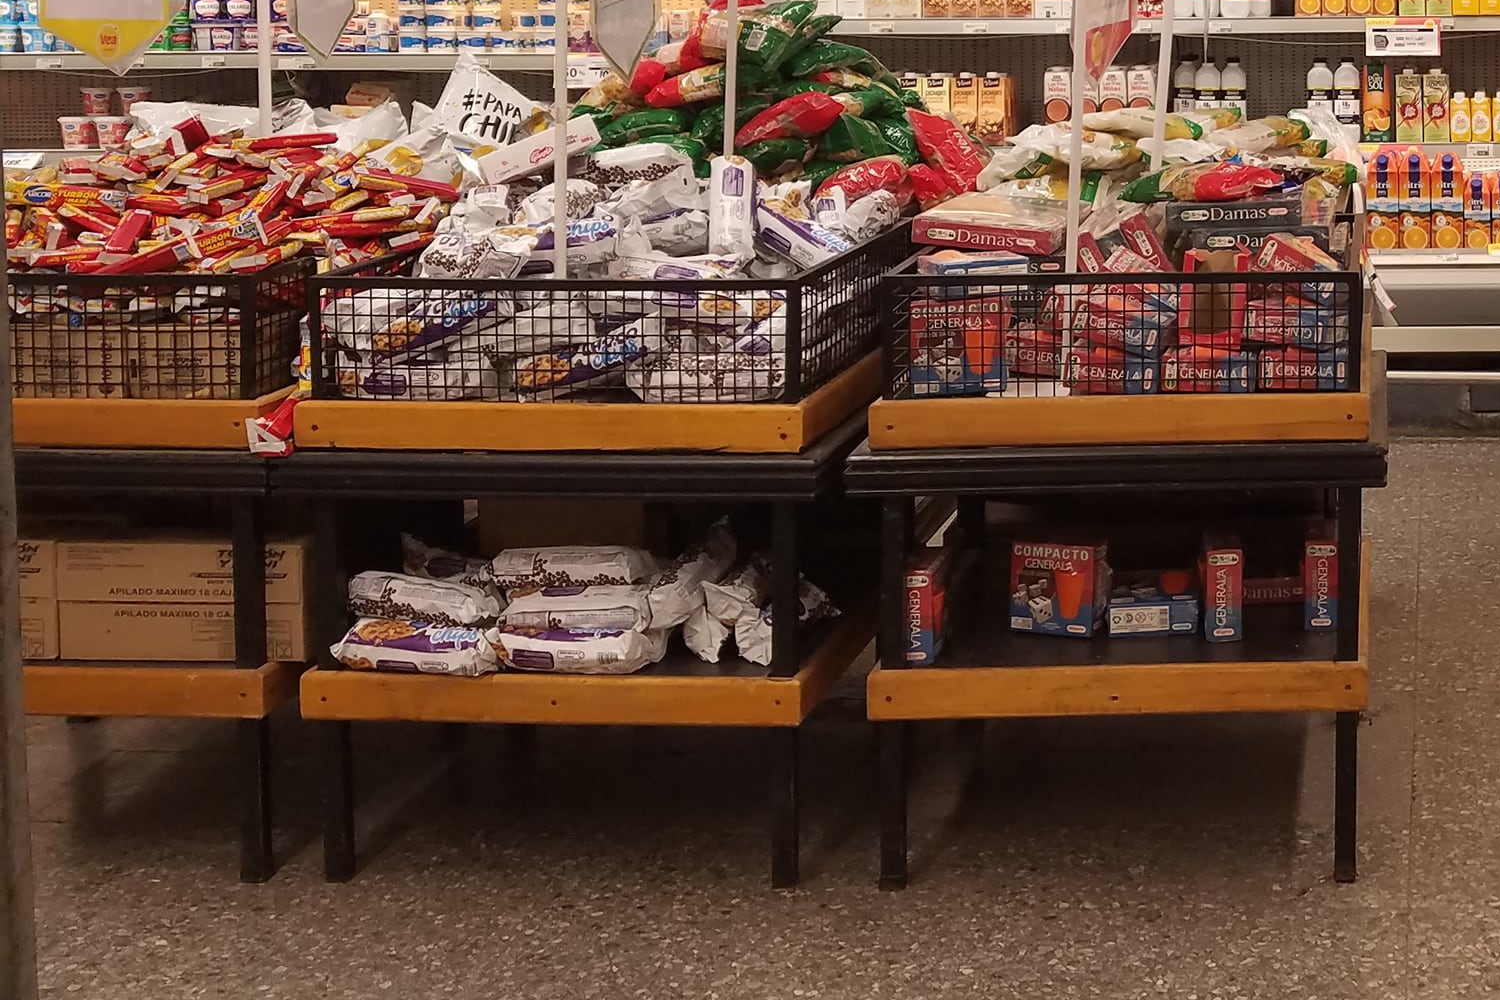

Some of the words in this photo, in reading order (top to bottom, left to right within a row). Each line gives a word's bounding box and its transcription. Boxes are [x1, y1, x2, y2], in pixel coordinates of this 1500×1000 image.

[101, 32, 117, 46] Vea
[1368, 81, 1384, 90] SOL
[461, 88, 522, 122] #PAPA
[1403, 181, 1426, 190] citric
[1436, 181, 1459, 190] citric
[25, 190, 52, 201] ARCOR
[57, 190, 99, 200] TURRÓN
[1467, 197, 1486, 207] citric
[1210, 206, 1267, 222] Damas
[813, 228, 849, 251] chips
[956, 228, 1014, 248] Damas
[911, 303, 998, 316] COMPACTO
[927, 317, 987, 330] GENERALA
[591, 336, 640, 367] chips
[1082, 364, 1141, 381] GENERALA
[1180, 367, 1238, 380] GENERALA
[1275, 364, 1334, 378] GENERALA
[1013, 545, 1089, 561] COMPACTO
[1025, 558, 1076, 571] GENERALA
[109, 588, 153, 596] APILADO
[156, 588, 195, 596] MAXIMO
[1318, 558, 1329, 617] GENERALA
[1216, 568, 1228, 627] GENERALA
[114, 610, 158, 618] APILADO
[160, 610, 200, 619] MAXIMO
[909, 590, 923, 649] GENERALA
